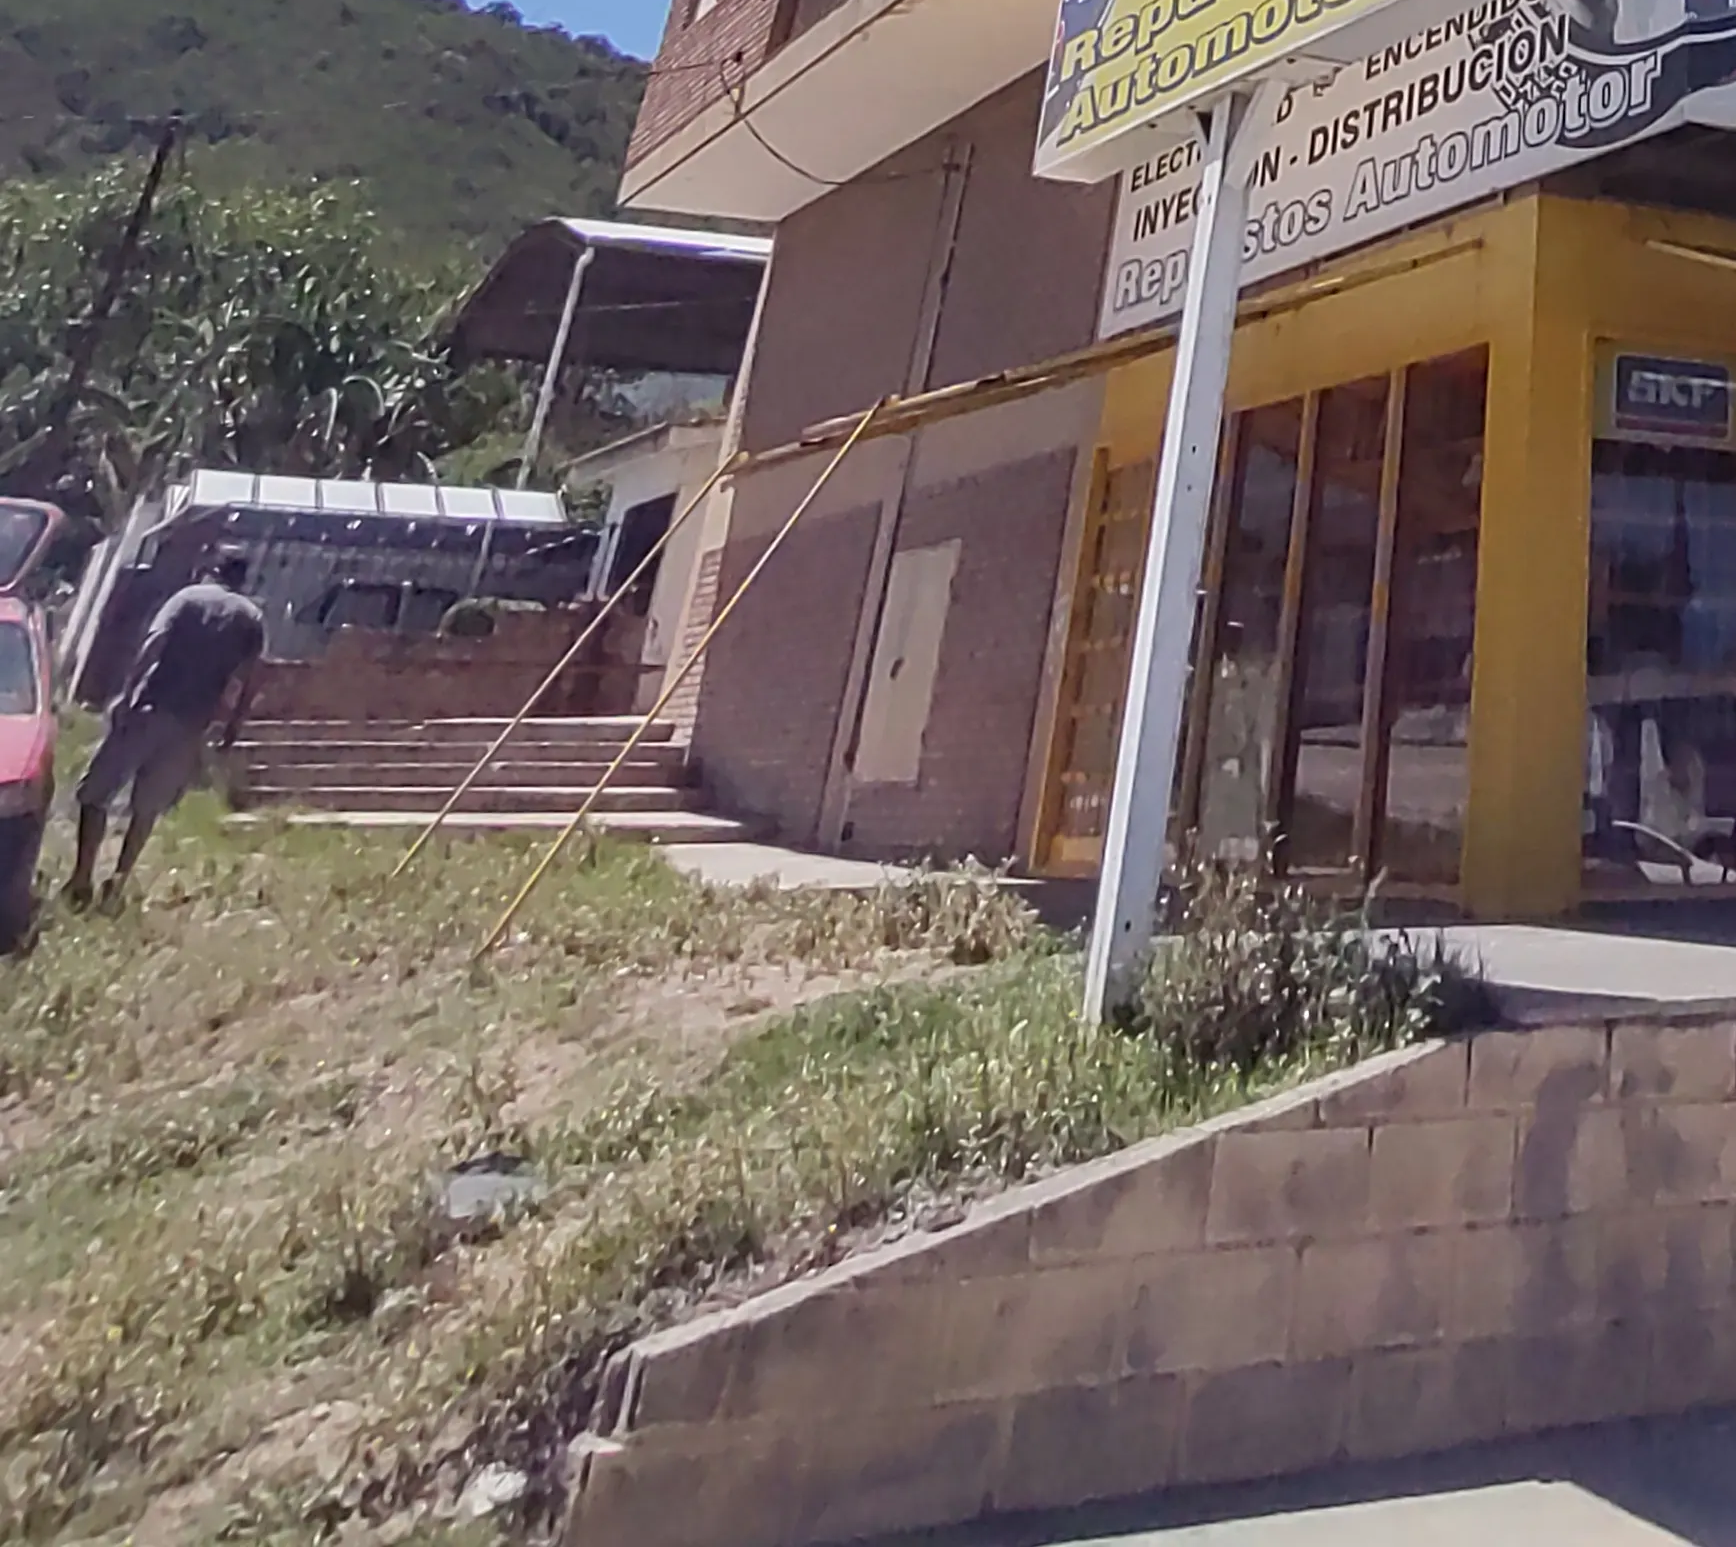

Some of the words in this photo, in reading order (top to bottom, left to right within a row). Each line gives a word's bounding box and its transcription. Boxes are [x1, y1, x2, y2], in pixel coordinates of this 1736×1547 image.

[1112, 189, 1332, 312] Repstos
[1343, 51, 1661, 222] Automotor
[1307, 13, 1568, 166] DISTRIBUCION
